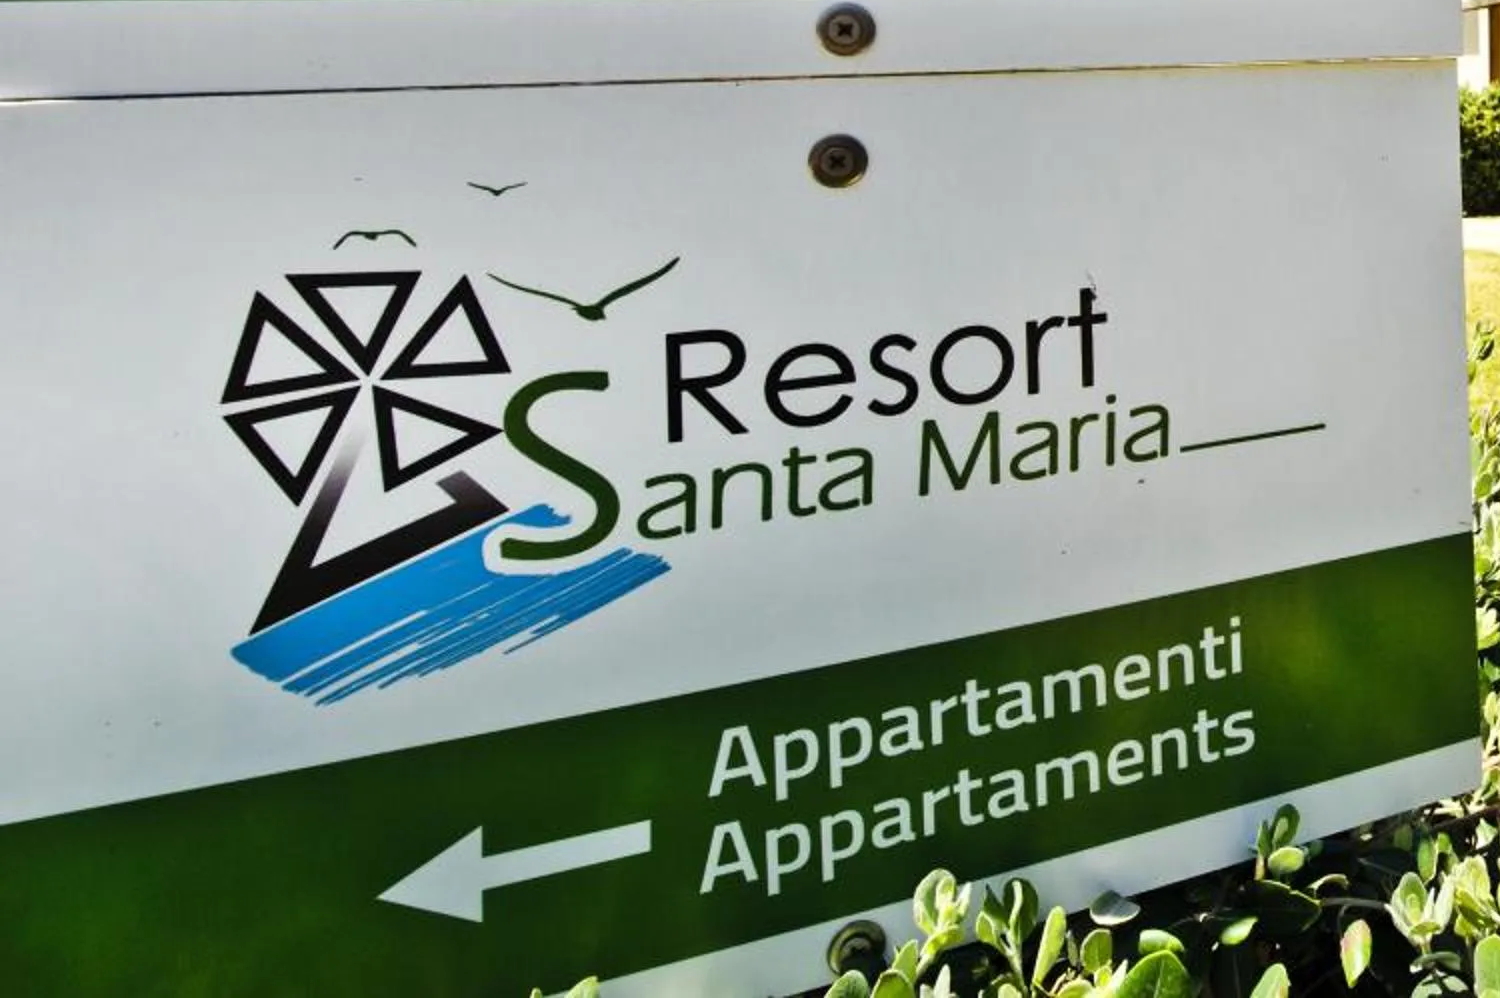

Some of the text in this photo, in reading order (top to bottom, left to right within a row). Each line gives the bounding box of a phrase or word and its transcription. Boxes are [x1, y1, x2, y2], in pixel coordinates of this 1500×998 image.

[664, 287, 1109, 444] Resort
[500, 370, 1172, 561] Santa Maria
[699, 707, 1257, 896] Appartaments
[707, 615, 1244, 802] Appartamenti
